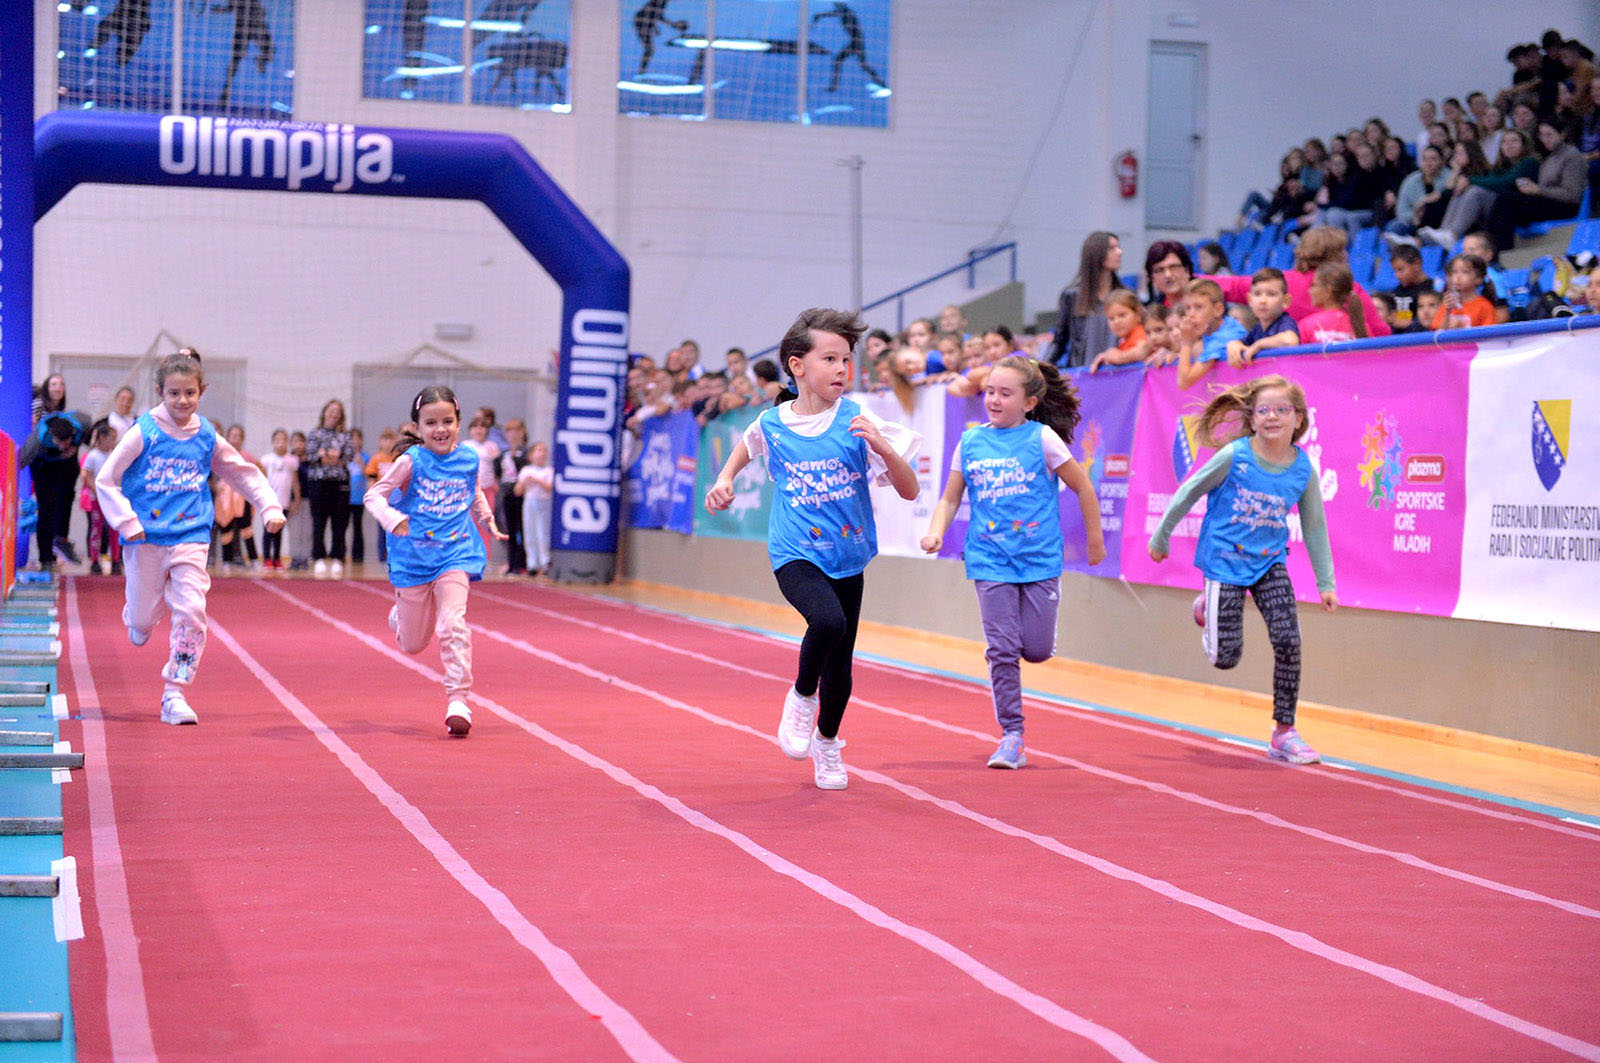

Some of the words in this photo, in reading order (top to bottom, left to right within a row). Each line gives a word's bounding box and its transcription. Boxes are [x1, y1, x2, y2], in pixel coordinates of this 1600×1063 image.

[159, 115, 394, 192] Olimpija
[555, 308, 630, 534] Olimpija
[1407, 459, 1442, 480] plazma
[1396, 491, 1446, 511] SPORTSKE
[1394, 513, 1416, 531] IGRE
[1491, 504, 1539, 529] FEDERALNO
[1393, 535, 1431, 553] MLADIH
[1490, 534, 1513, 556] RADA
